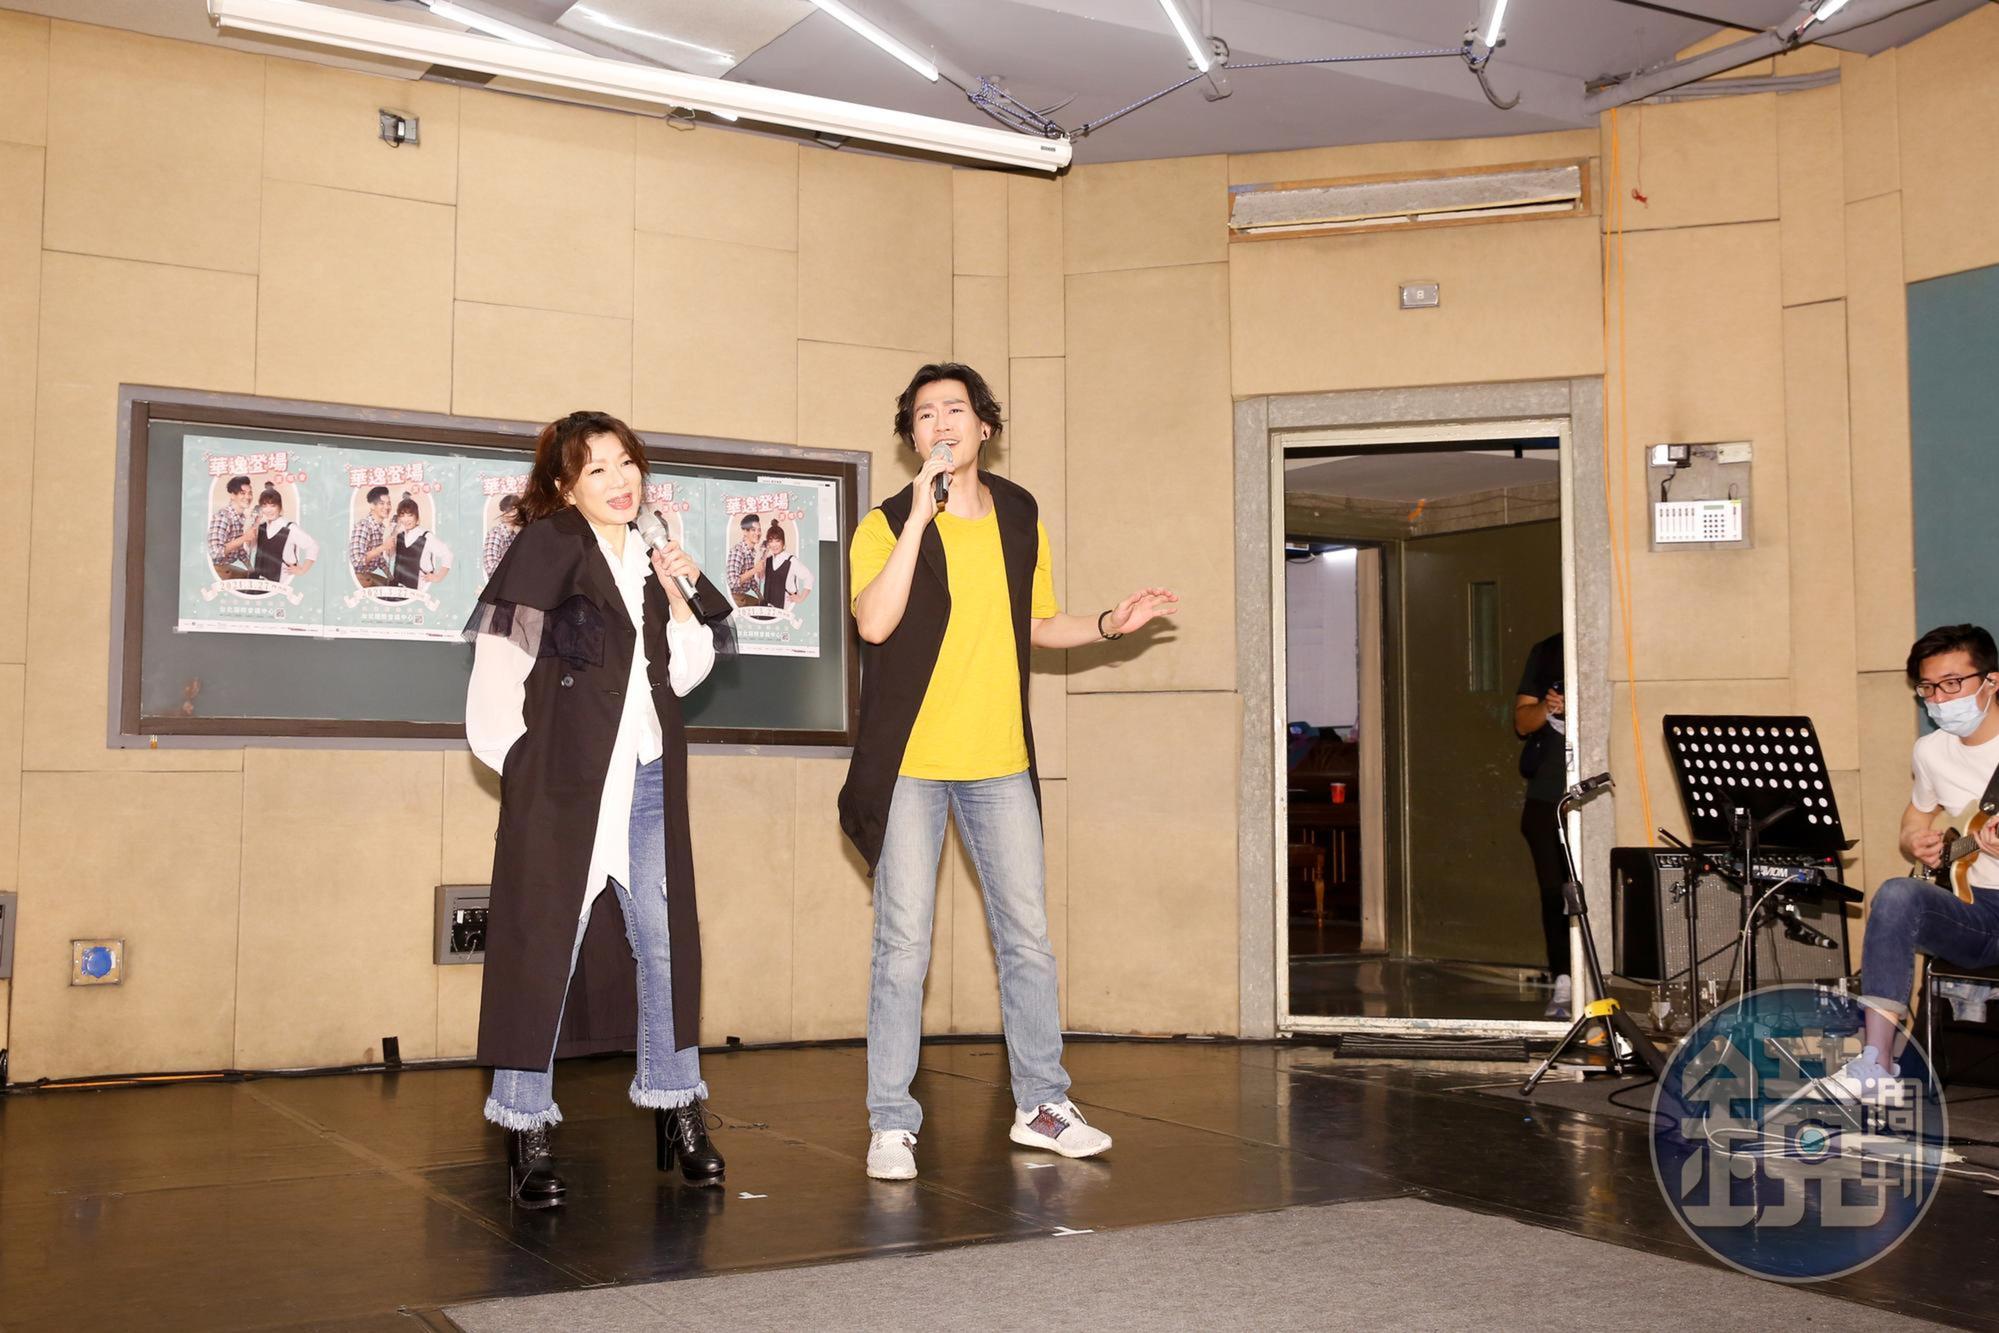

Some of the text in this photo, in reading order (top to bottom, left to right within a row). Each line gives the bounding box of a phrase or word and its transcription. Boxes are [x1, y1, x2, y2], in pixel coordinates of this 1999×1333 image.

[209, 452, 288, 476] 華逸登場
[350, 464, 424, 487] 華逸登場
[726, 493, 788, 515] 華逸登場
